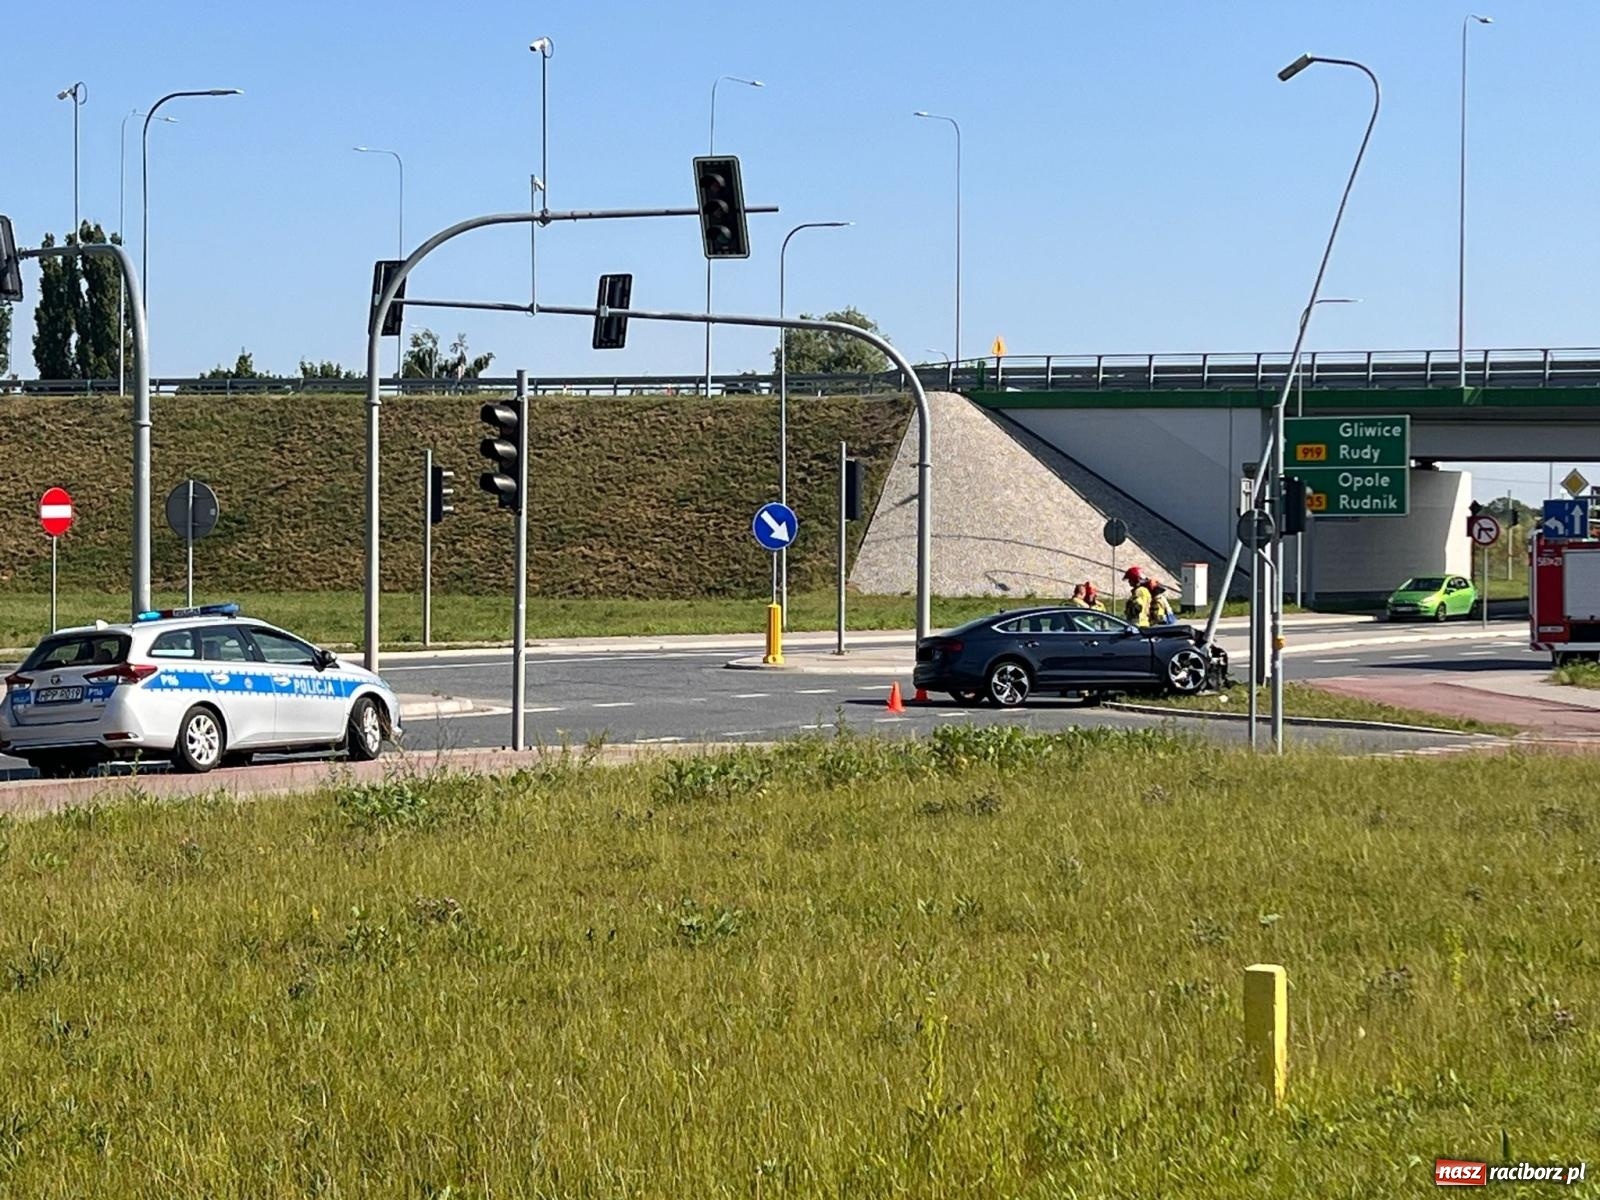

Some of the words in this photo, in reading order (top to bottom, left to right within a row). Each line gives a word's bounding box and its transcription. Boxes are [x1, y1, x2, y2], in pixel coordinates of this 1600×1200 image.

[1339, 422, 1402, 437] Gliwice
[1301, 447, 1323, 459] 919
[1339, 444, 1381, 464] Rudy
[1338, 472, 1391, 491] Opole
[1306, 495, 1323, 507] 35
[1339, 494, 1398, 509] Rudnik
[293, 679, 335, 696] POLICJA
